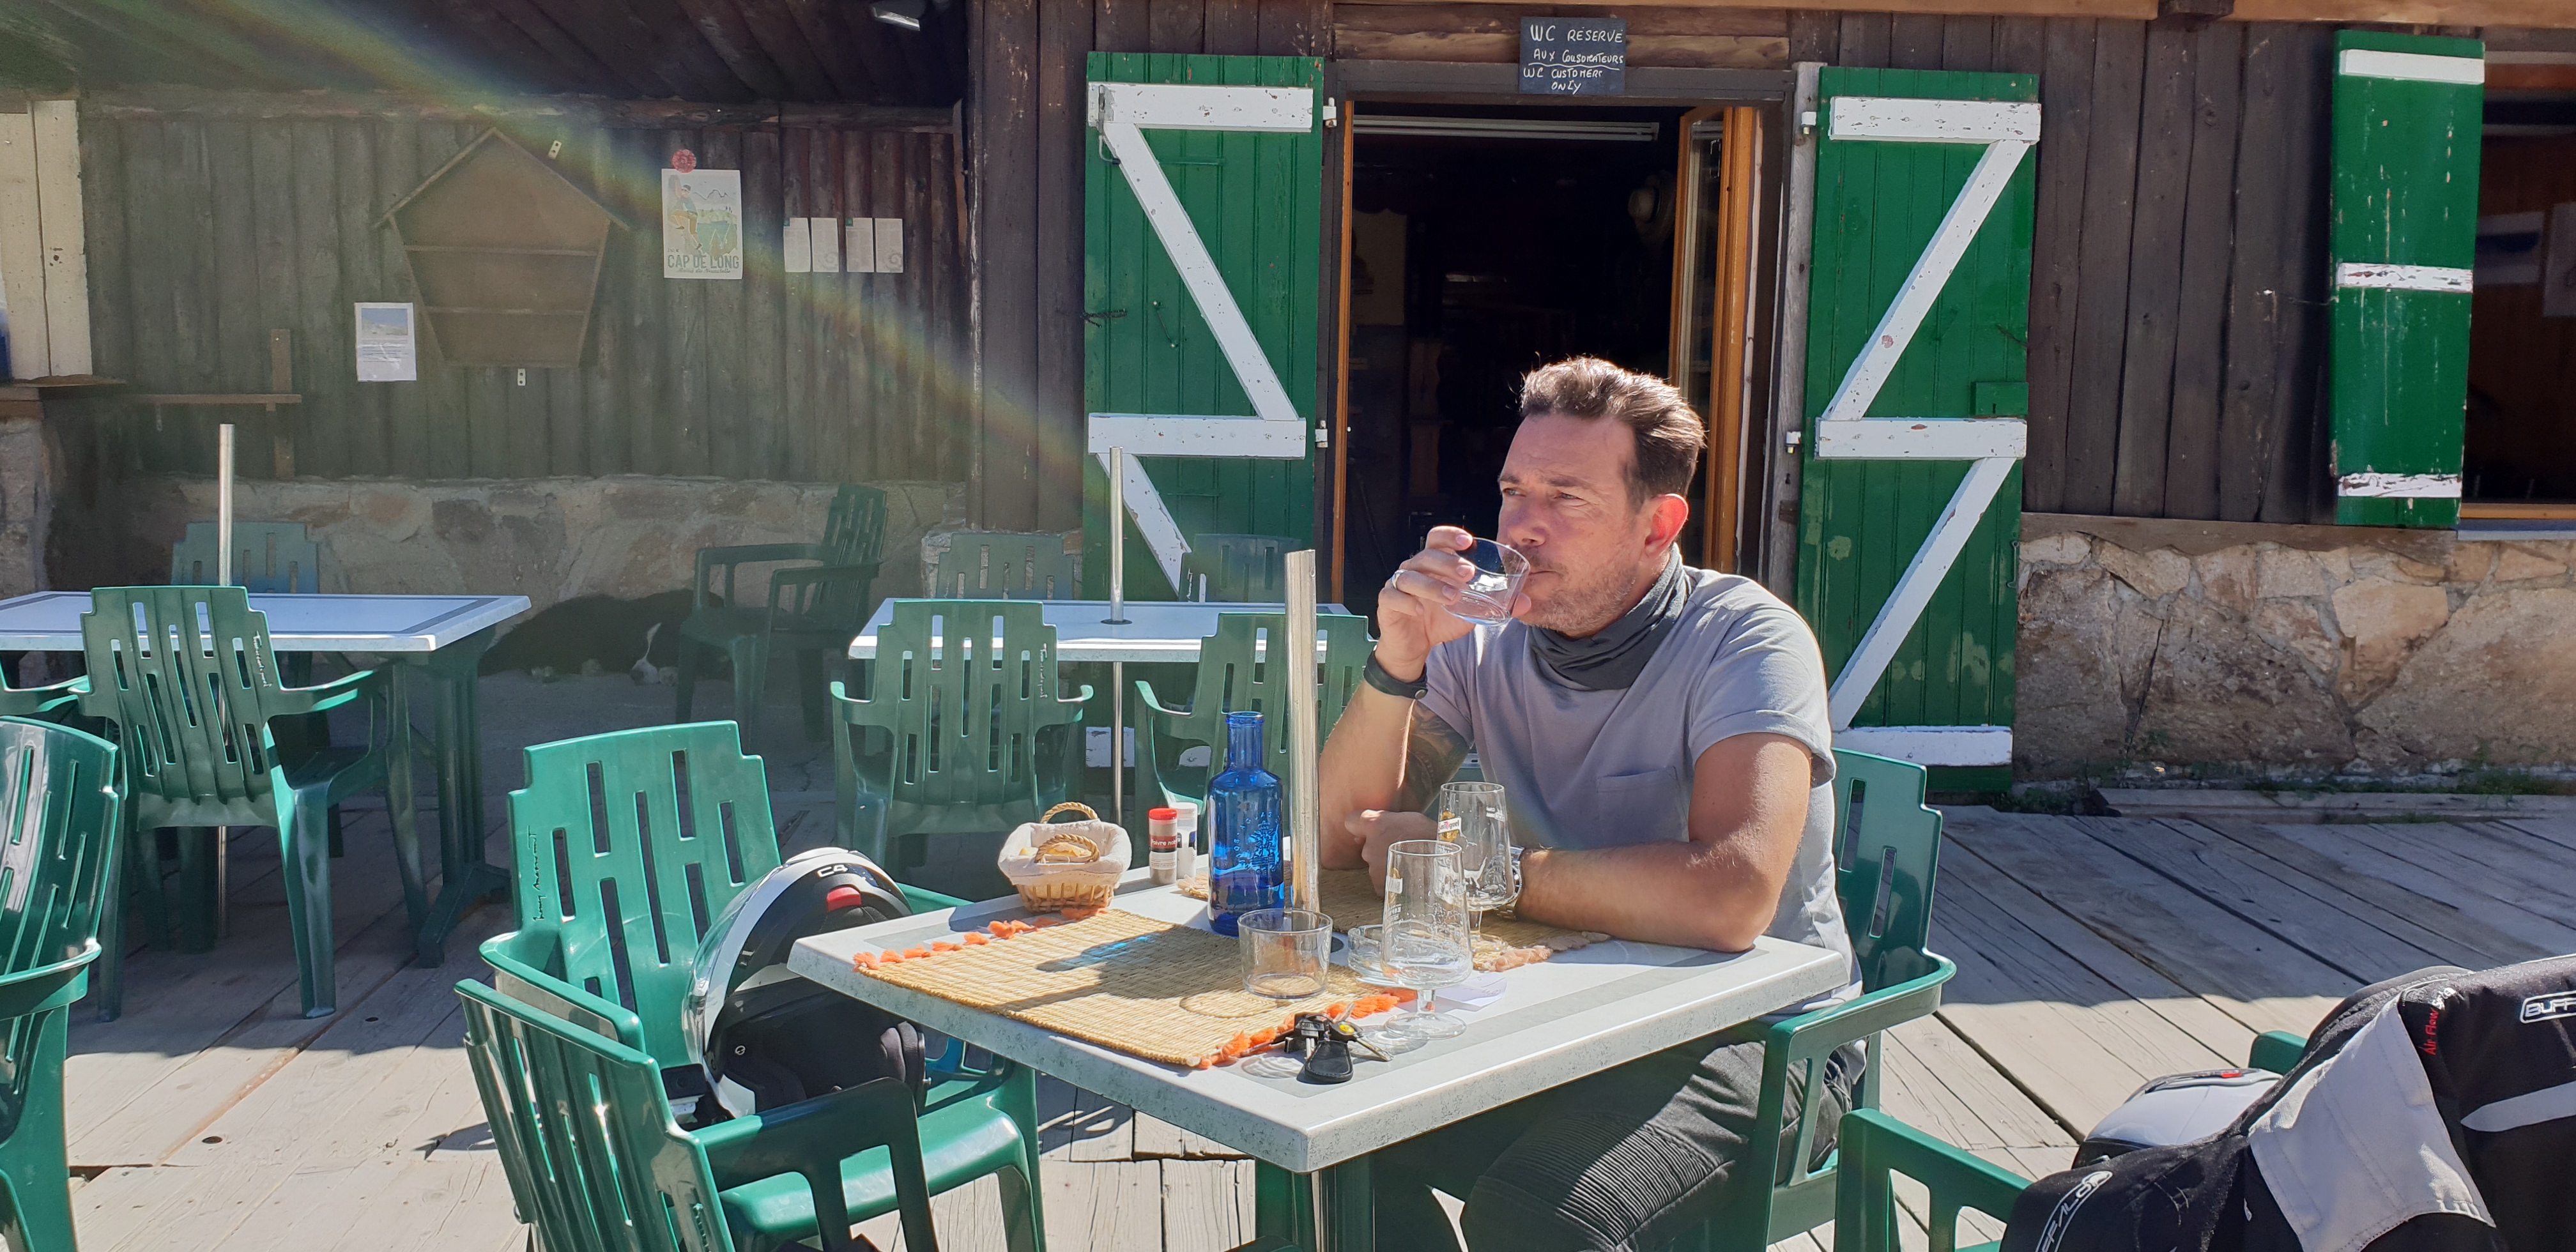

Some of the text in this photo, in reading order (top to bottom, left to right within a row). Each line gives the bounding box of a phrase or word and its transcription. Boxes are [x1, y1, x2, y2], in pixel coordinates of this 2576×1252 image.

[1530, 24, 1556, 42] WC
[1533, 48, 1555, 62] AUX
[1523, 67, 1544, 78] WC
[1551, 80, 1582, 95] ONLY
[667, 254, 739, 269] CAP DE LONG
[2423, 1008, 2440, 1056] Air Flow
